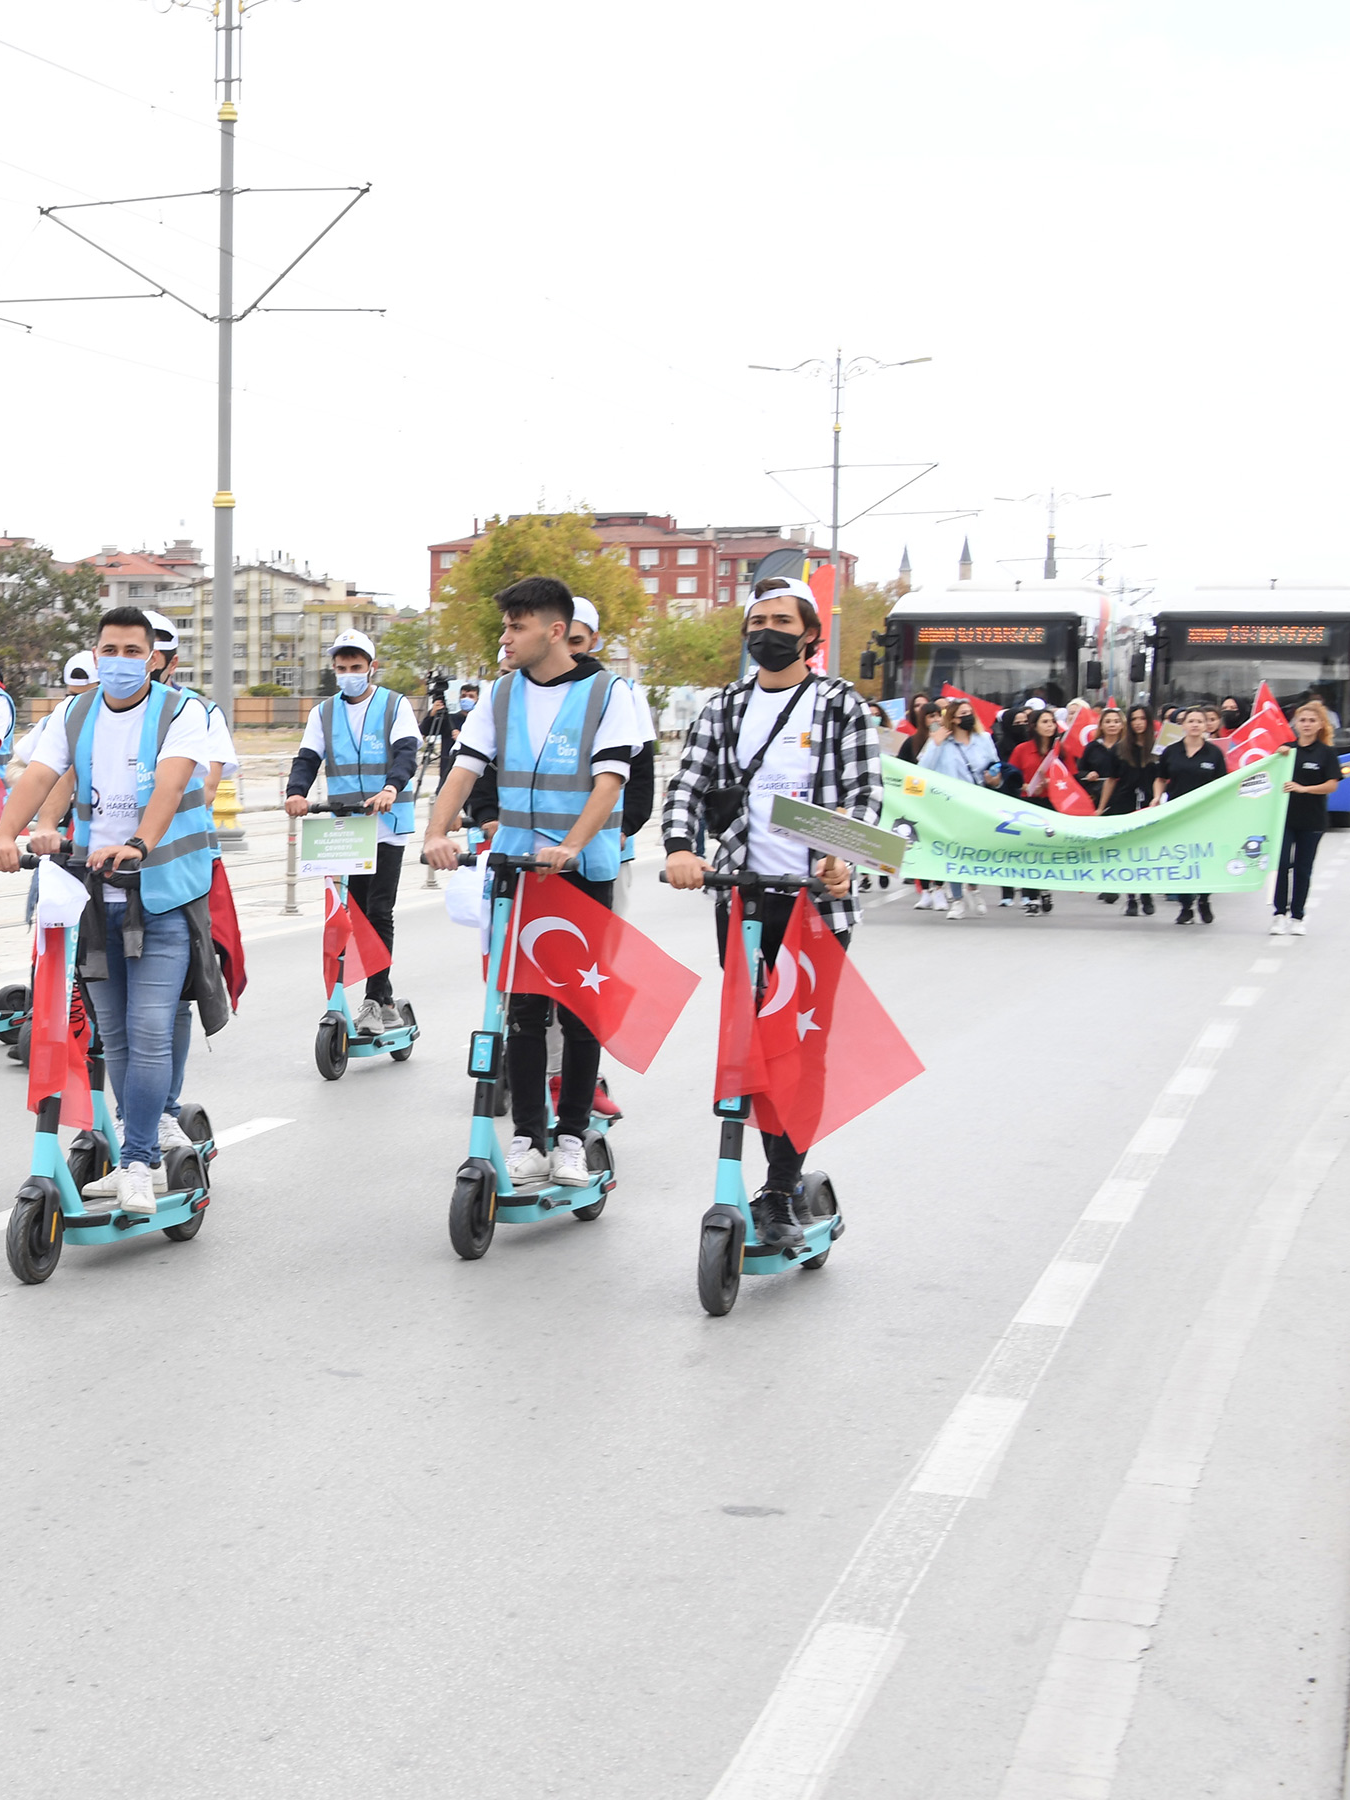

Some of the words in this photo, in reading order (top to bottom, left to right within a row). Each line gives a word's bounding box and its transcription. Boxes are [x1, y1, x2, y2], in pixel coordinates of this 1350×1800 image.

[931, 840, 1122, 865] SÜRDÜRÜLEBİLİR
[1128, 841, 1215, 864] ULAŞIM
[945, 861, 1095, 882] FARKINDALIK
[1102, 861, 1201, 882] KORTEJİ
